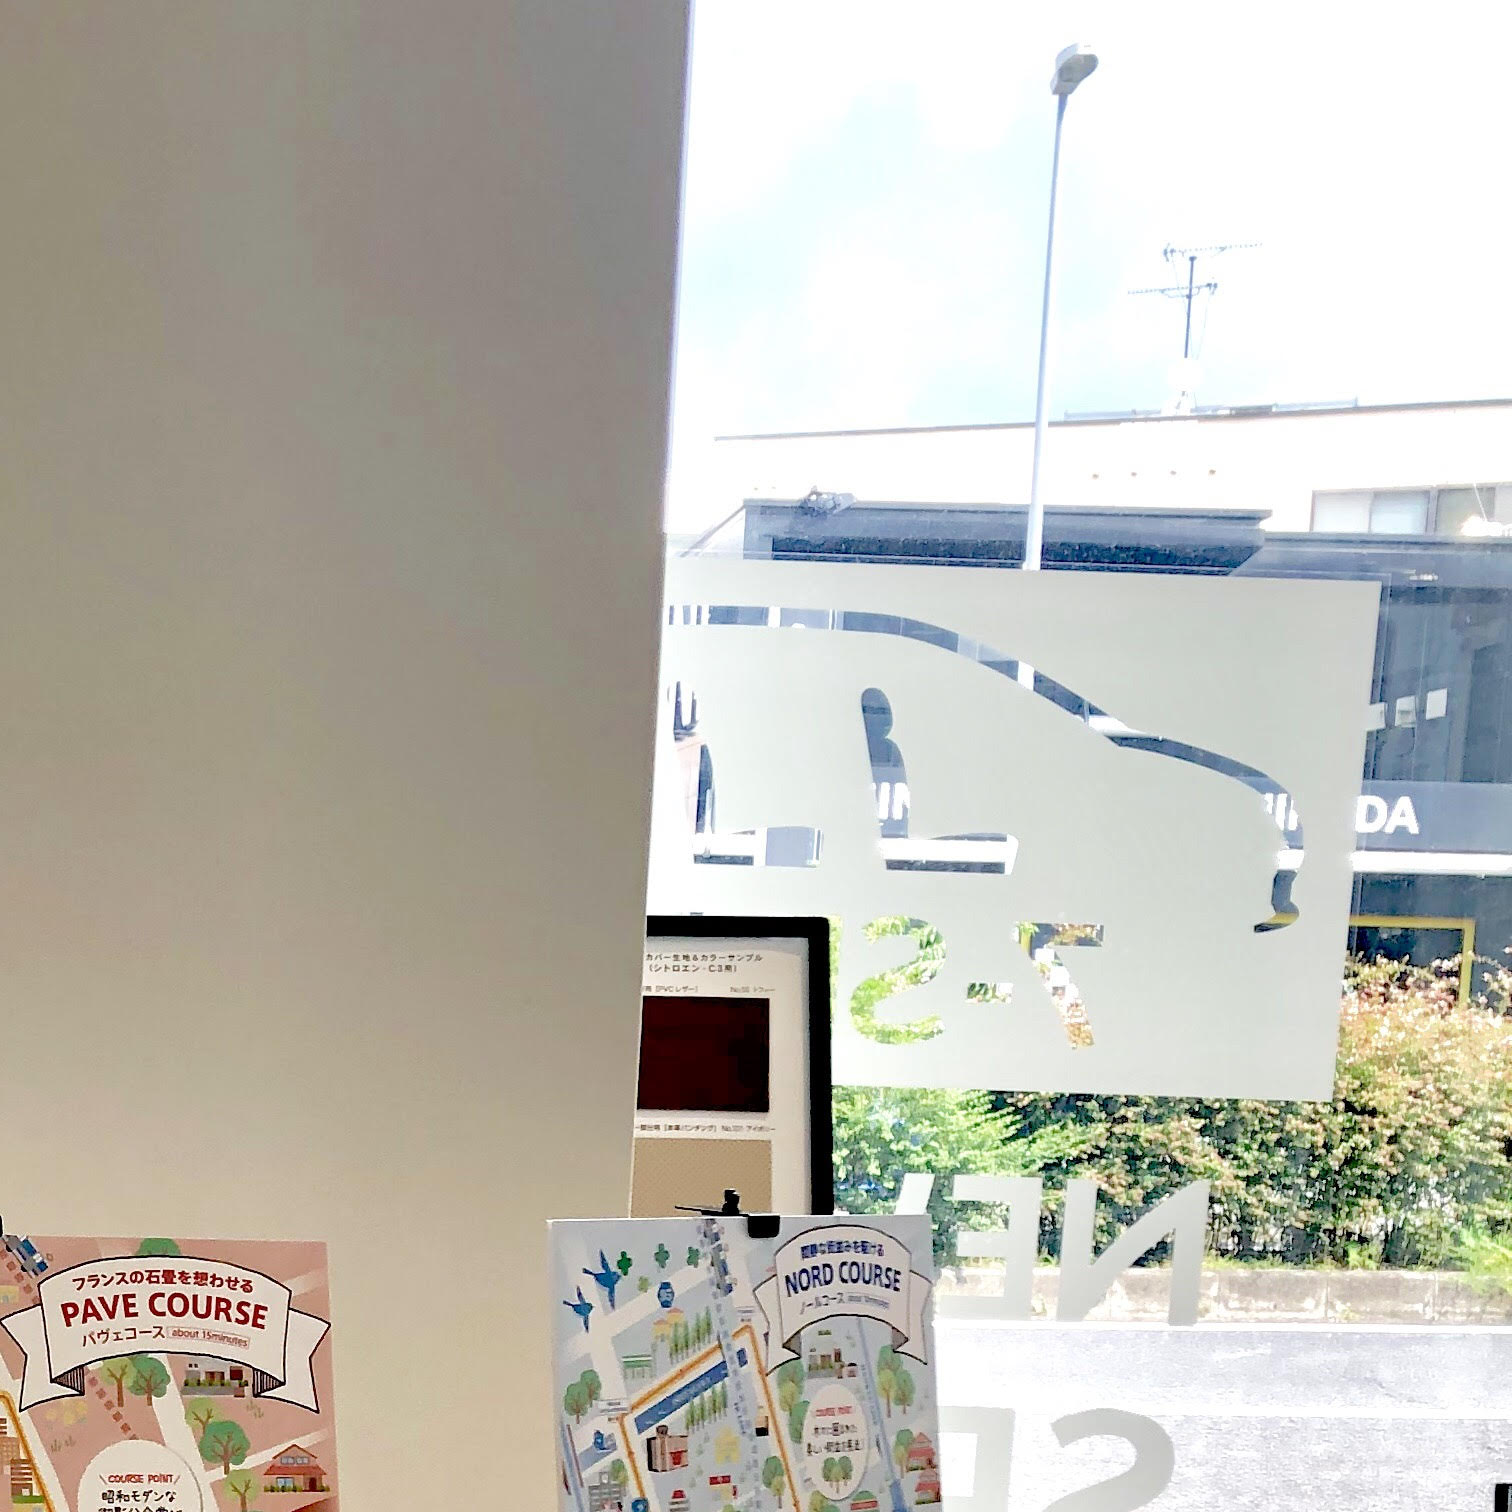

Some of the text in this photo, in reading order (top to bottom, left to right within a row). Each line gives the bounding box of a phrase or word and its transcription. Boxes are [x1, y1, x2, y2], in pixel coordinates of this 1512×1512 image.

[72, 1268, 255, 1294] フランスの石畳を想わせる
[784, 1260, 901, 1298] NORD COURSE
[61, 1292, 270, 1331] PAVE COURSE
[82, 1325, 166, 1347] パヴェコース
[171, 1327, 249, 1348] about 15minutes
[107, 1472, 174, 1485] COURSE POINT
[101, 1489, 177, 1504] 昭和モダンな
